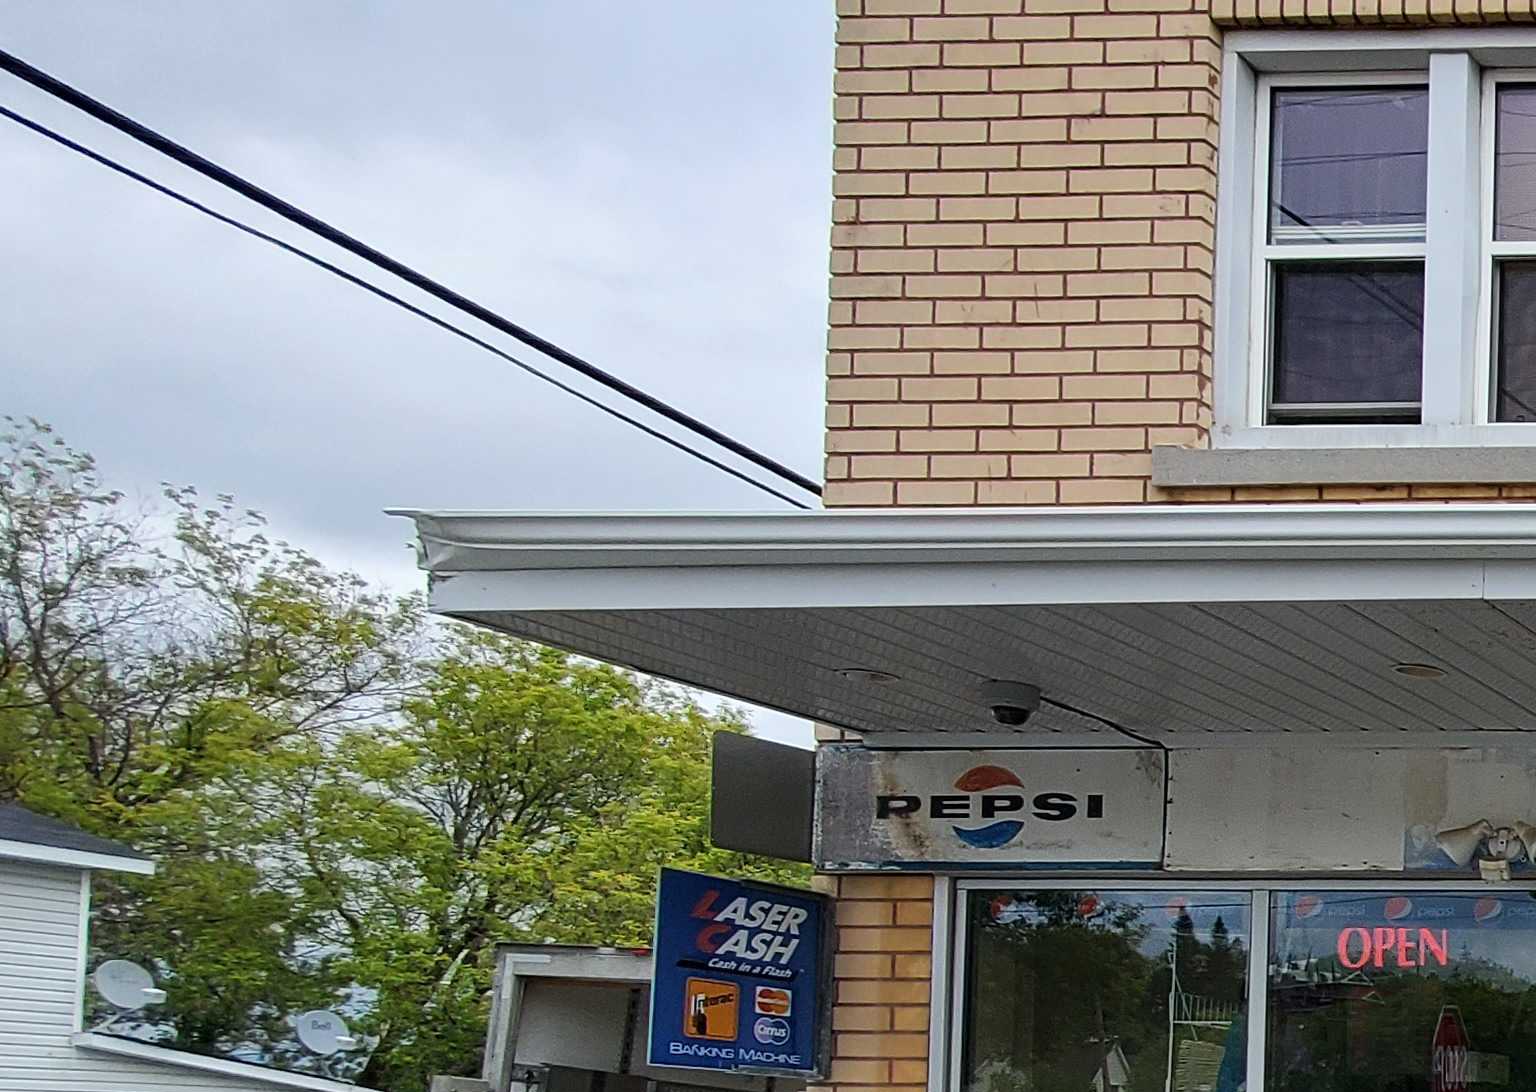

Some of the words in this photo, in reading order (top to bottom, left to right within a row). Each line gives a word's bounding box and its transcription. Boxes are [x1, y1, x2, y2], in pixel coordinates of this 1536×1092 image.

[876, 792, 1103, 821] PEPSI
[691, 889, 808, 935] LASER
[696, 922, 800, 965] CASH
[1337, 927, 1448, 969] OPEN
[708, 958, 737, 970] Cash
[738, 962, 752, 972] in
[752, 965, 762, 974] a
[762, 965, 793, 978] Flash
[670, 1042, 735, 1059] BANKING
[738, 1047, 801, 1065] MACHINE
